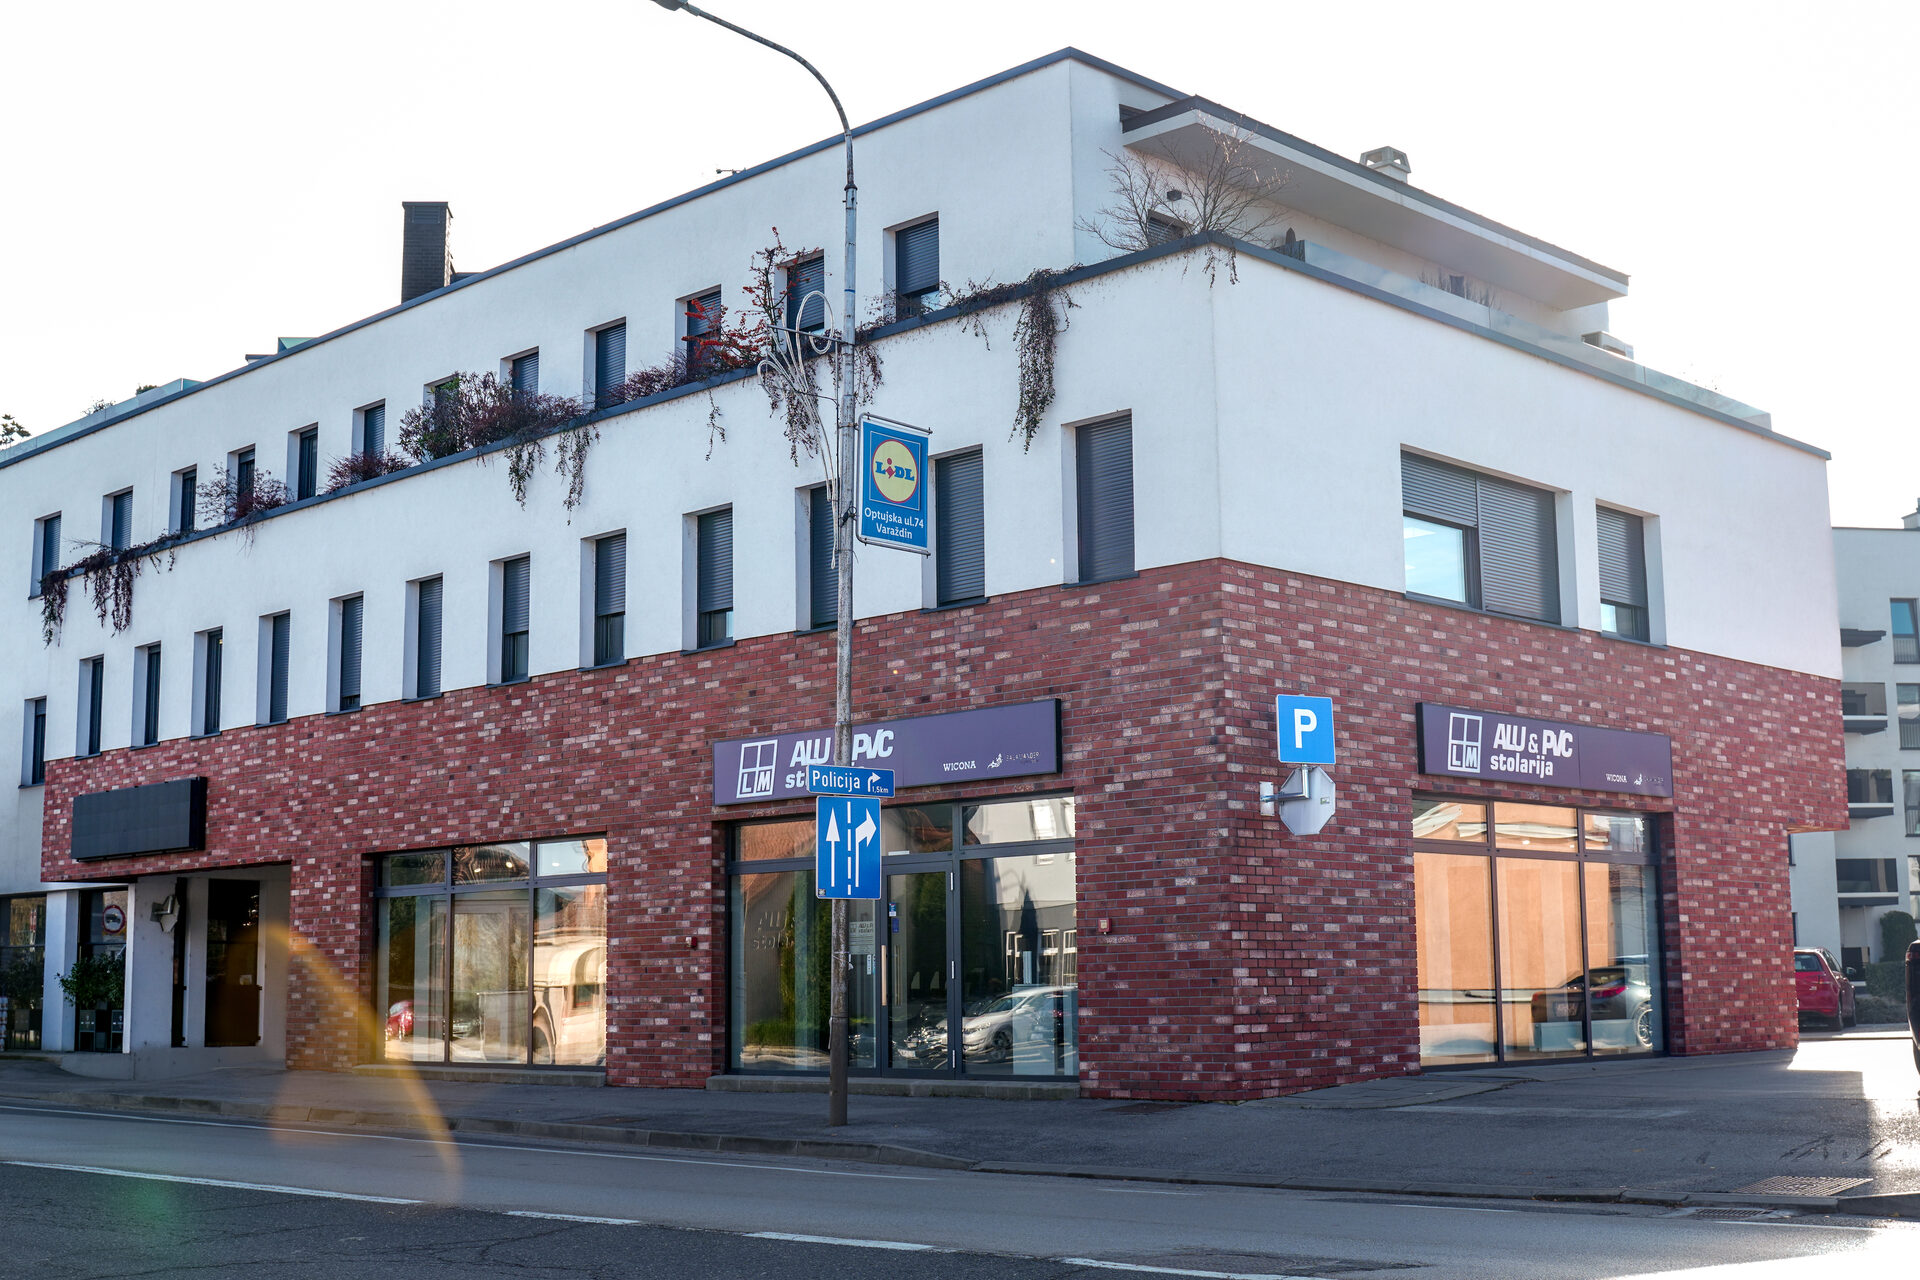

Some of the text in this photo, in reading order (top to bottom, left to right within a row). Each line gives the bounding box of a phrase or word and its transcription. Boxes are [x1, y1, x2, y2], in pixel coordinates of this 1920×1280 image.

[864, 507, 924, 529] Optujska ul.74
[875, 522, 912, 539] Varaždin
[1294, 708, 1317, 748] P
[789, 728, 894, 767] ALU PVC
[1493, 723, 1573, 758] ALU & PVC
[943, 760, 976, 771] WICONA
[1490, 752, 1554, 779] stolarija
[812, 770, 860, 792] Policija
